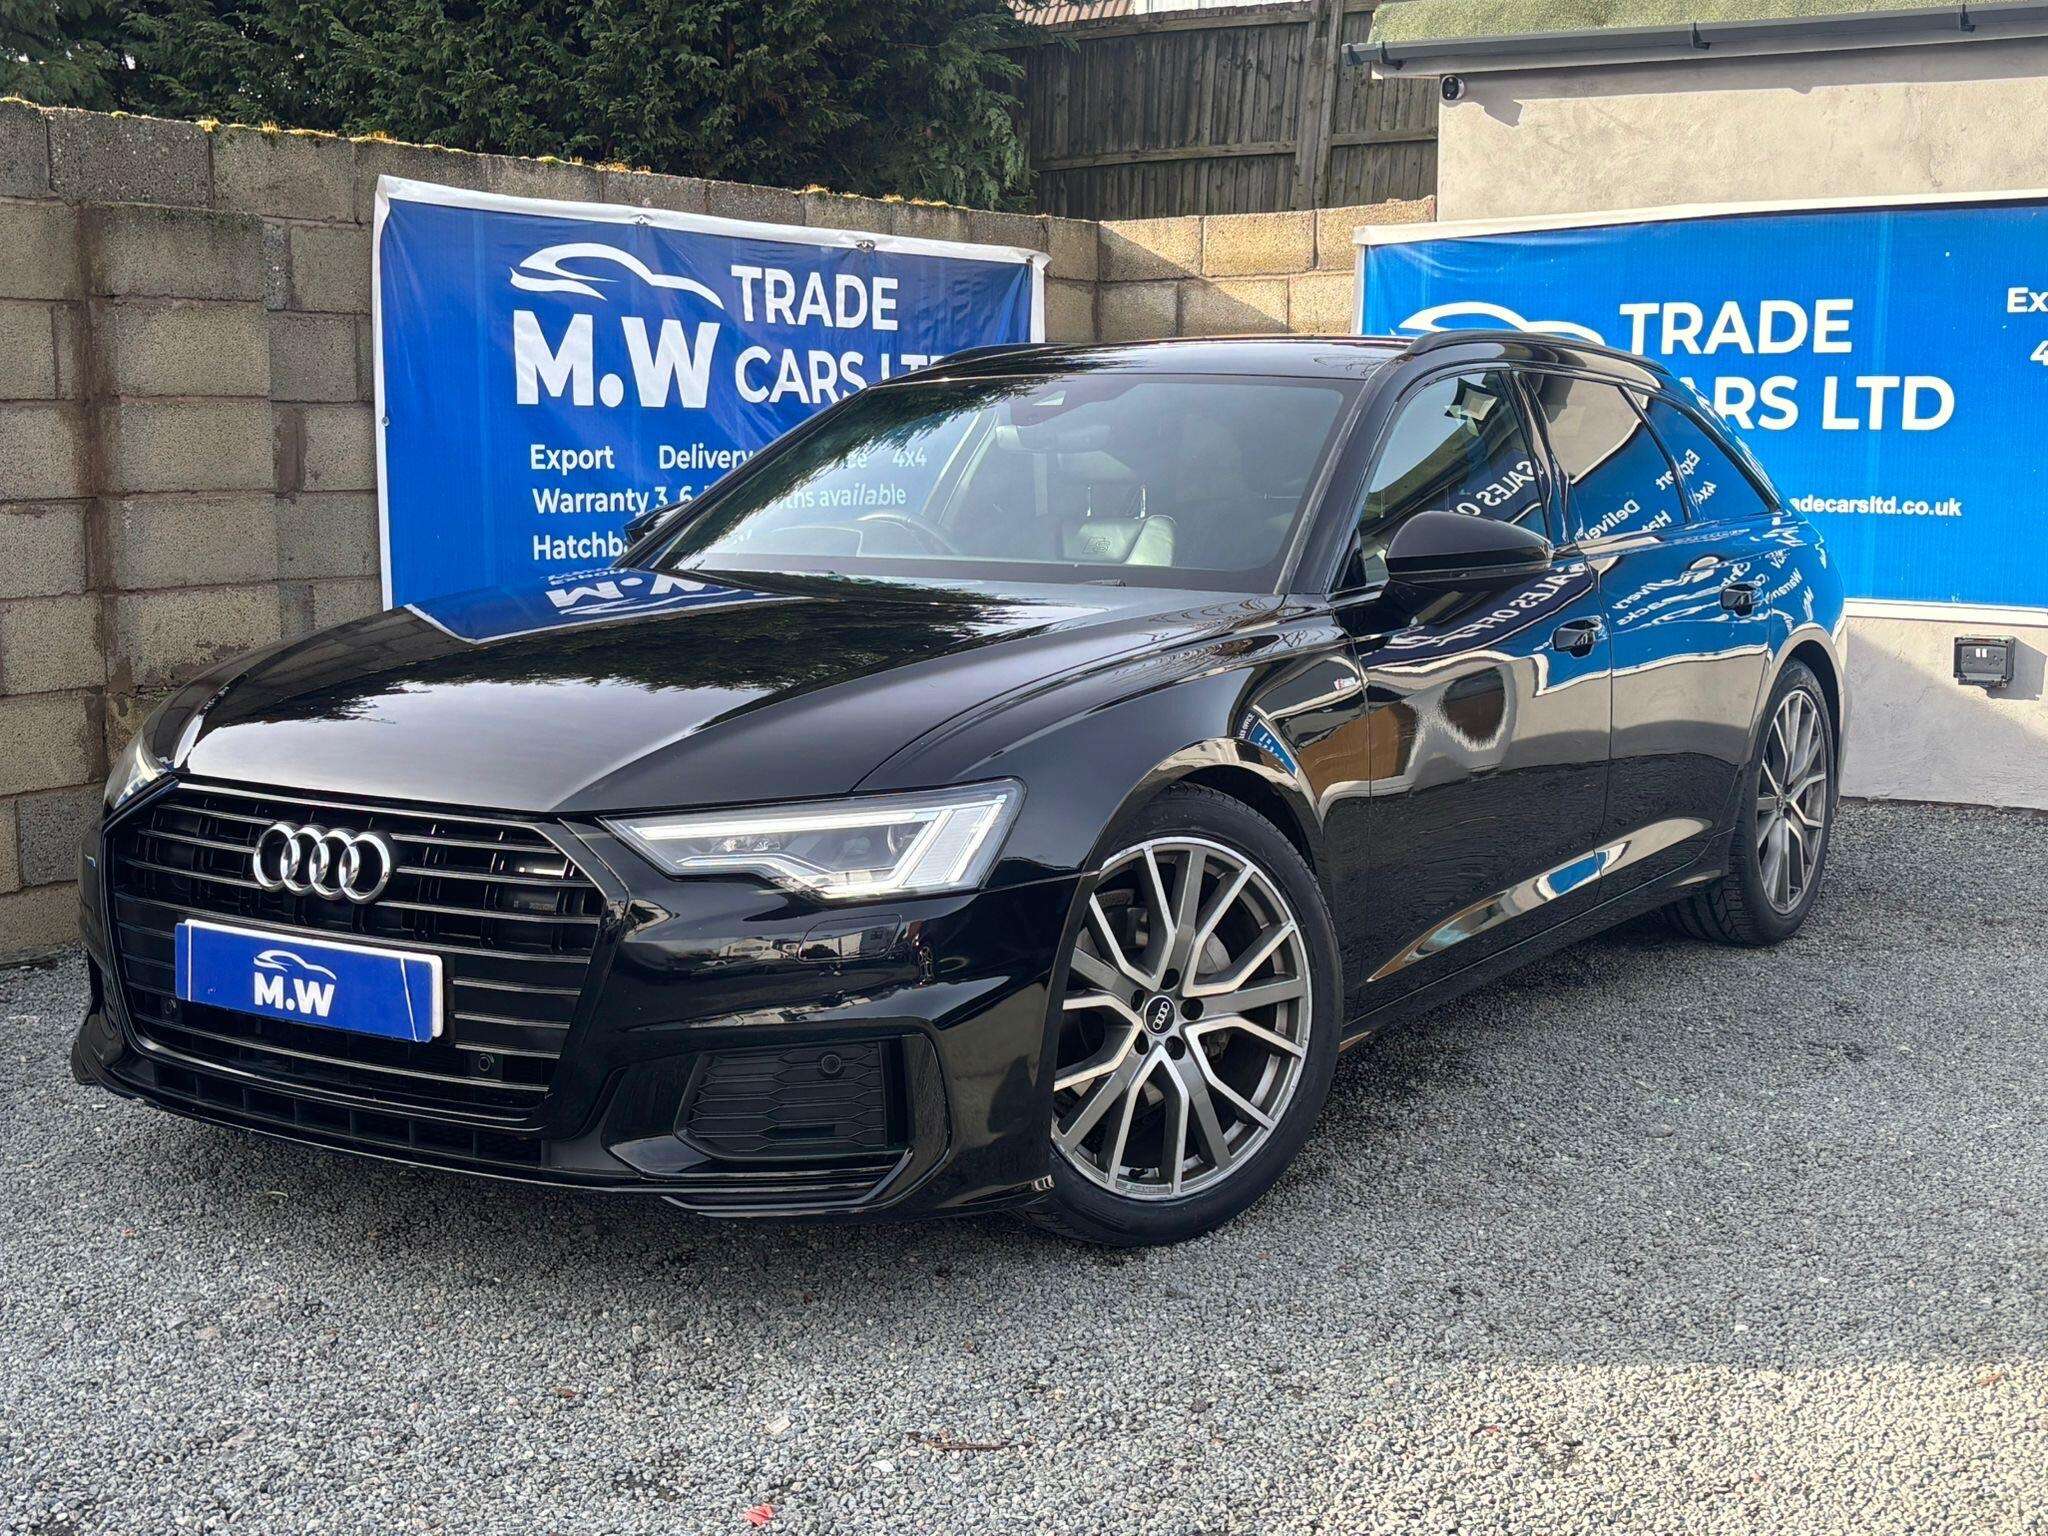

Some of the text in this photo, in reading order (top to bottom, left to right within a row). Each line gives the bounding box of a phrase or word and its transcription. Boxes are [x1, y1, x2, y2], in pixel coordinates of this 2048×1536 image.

[731, 265, 899, 331] TRADE
[1619, 299, 1853, 356] TRADE
[514, 309, 720, 408] M.W
[735, 346, 867, 404] CARS
[1679, 376, 1956, 430] RS LTD
[530, 444, 616, 475] Export
[892, 447, 927, 468] 4x4
[532, 487, 649, 516] Warranty
[819, 482, 906, 507] available
[533, 531, 628, 560] Hatchb
[253, 972, 335, 1017] M.W
